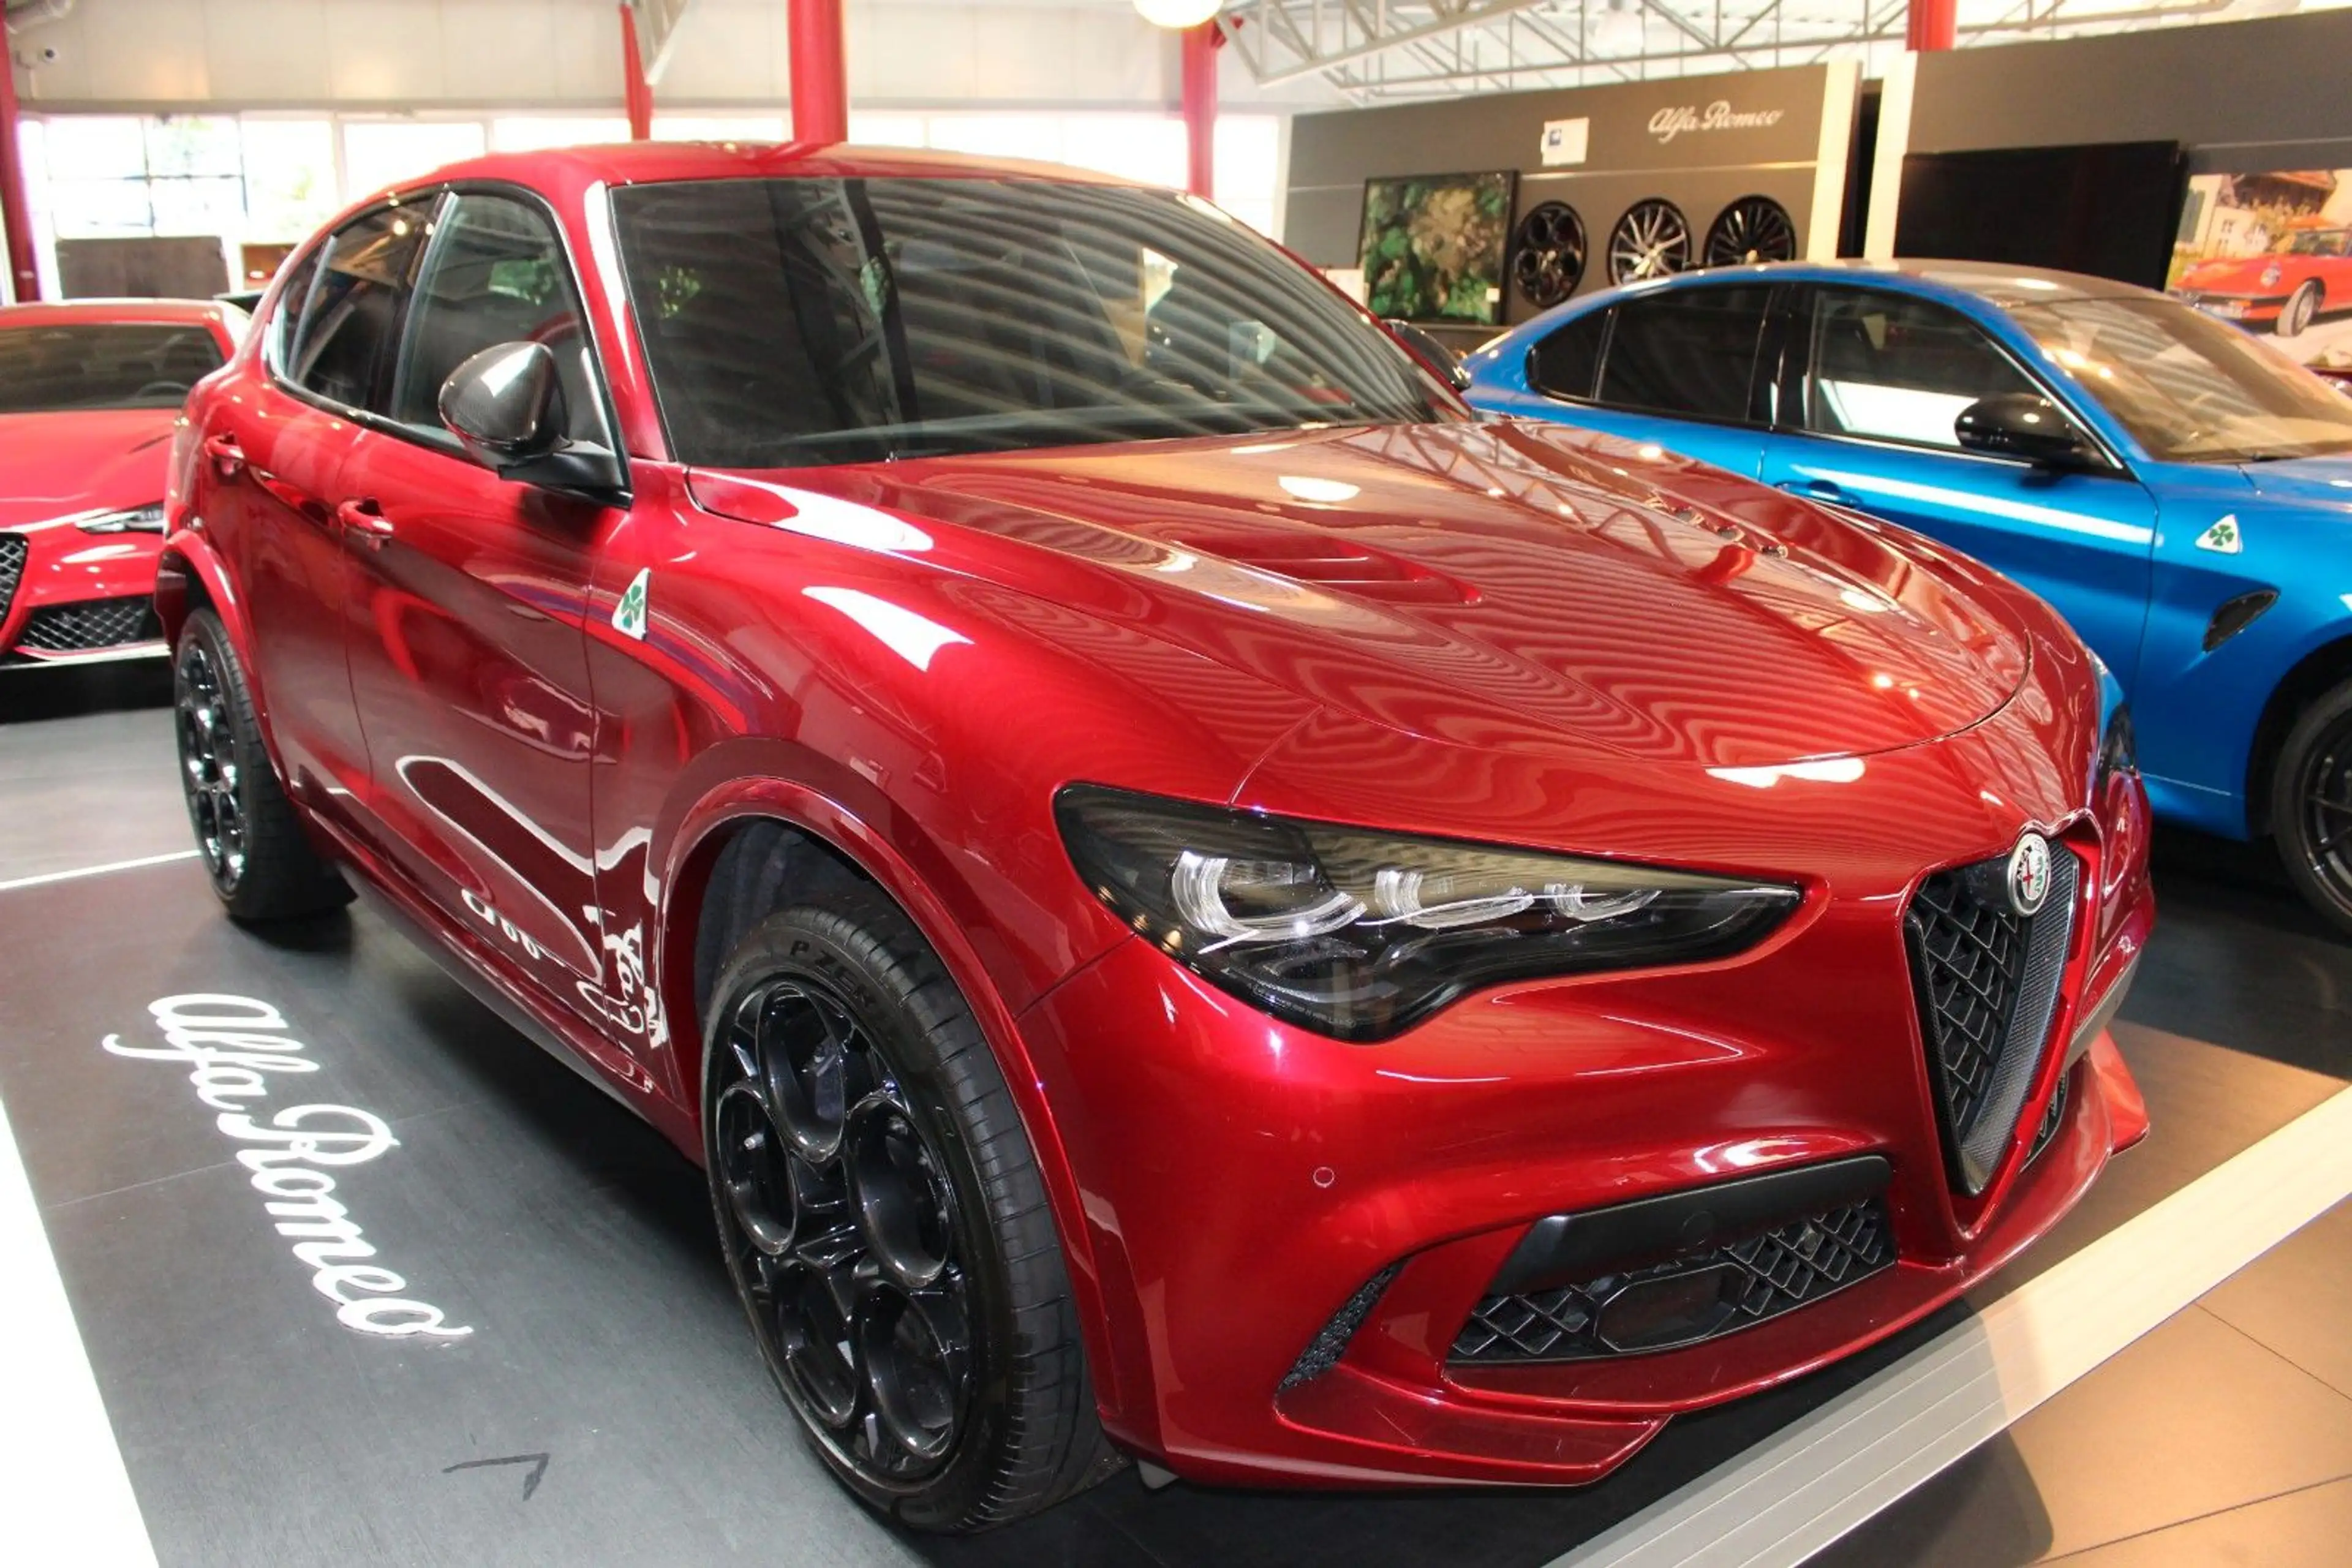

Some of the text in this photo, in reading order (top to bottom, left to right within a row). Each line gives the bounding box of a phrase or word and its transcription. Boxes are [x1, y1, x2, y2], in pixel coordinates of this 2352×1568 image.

[1648, 100, 1784, 145] Alfa Romeo
[102, 993, 474, 1338] Alfa Romeo
